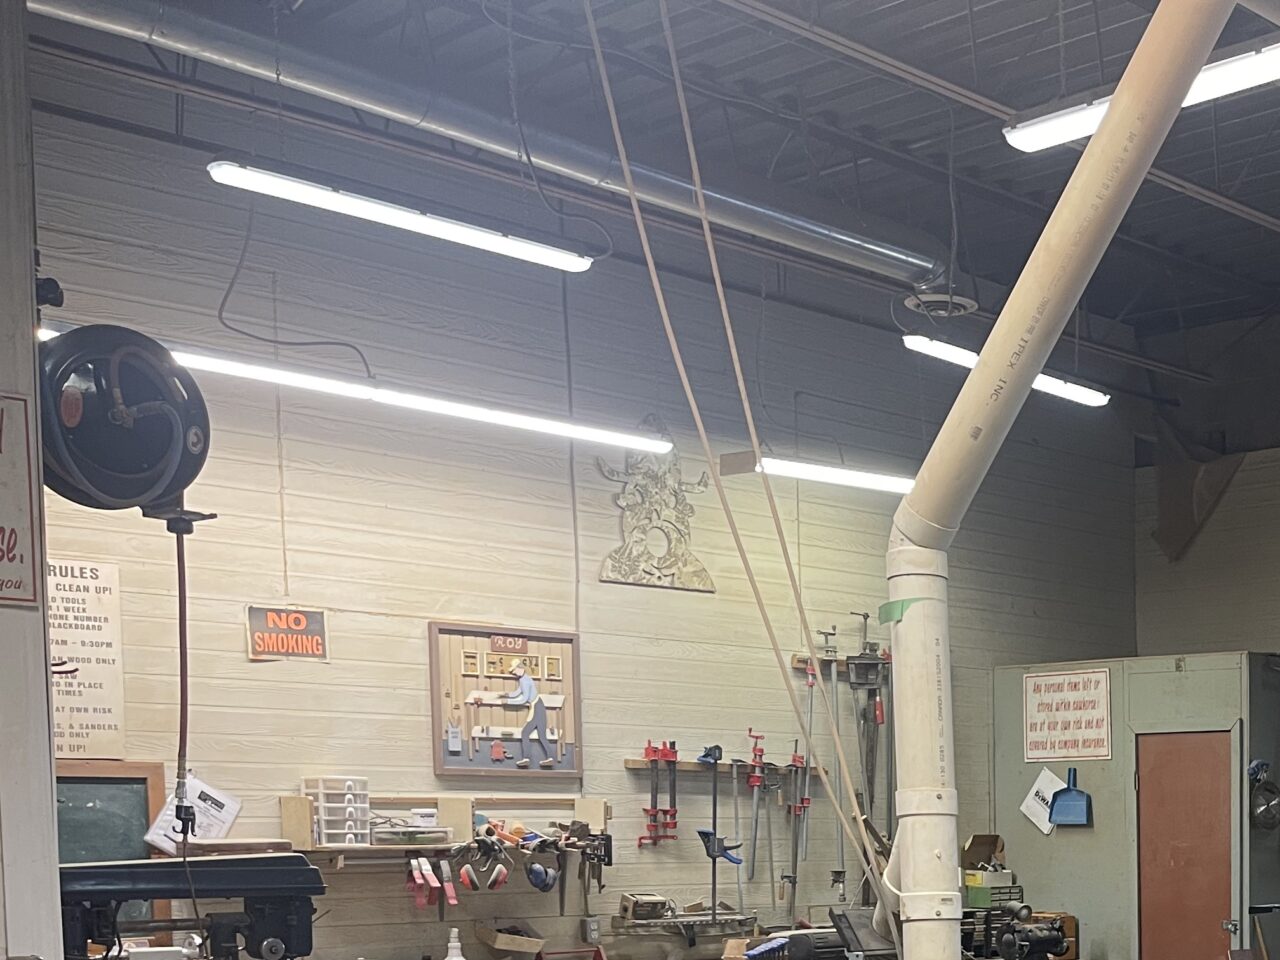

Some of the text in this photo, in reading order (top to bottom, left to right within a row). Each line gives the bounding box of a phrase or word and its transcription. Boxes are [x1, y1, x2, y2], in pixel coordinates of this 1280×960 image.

[48, 564, 100, 580] RULES
[56, 583, 112, 595] CLEAN UP!
[61, 597, 86, 605] TOOLS
[74, 615, 109, 623] NUMBER
[266, 611, 307, 630] NO
[254, 632, 323, 654] SMOKING
[1044, 678, 1065, 696] personal
[1040, 719, 1045, 732] at
[1029, 738, 1048, 751] covered
[1058, 738, 1079, 752] company
